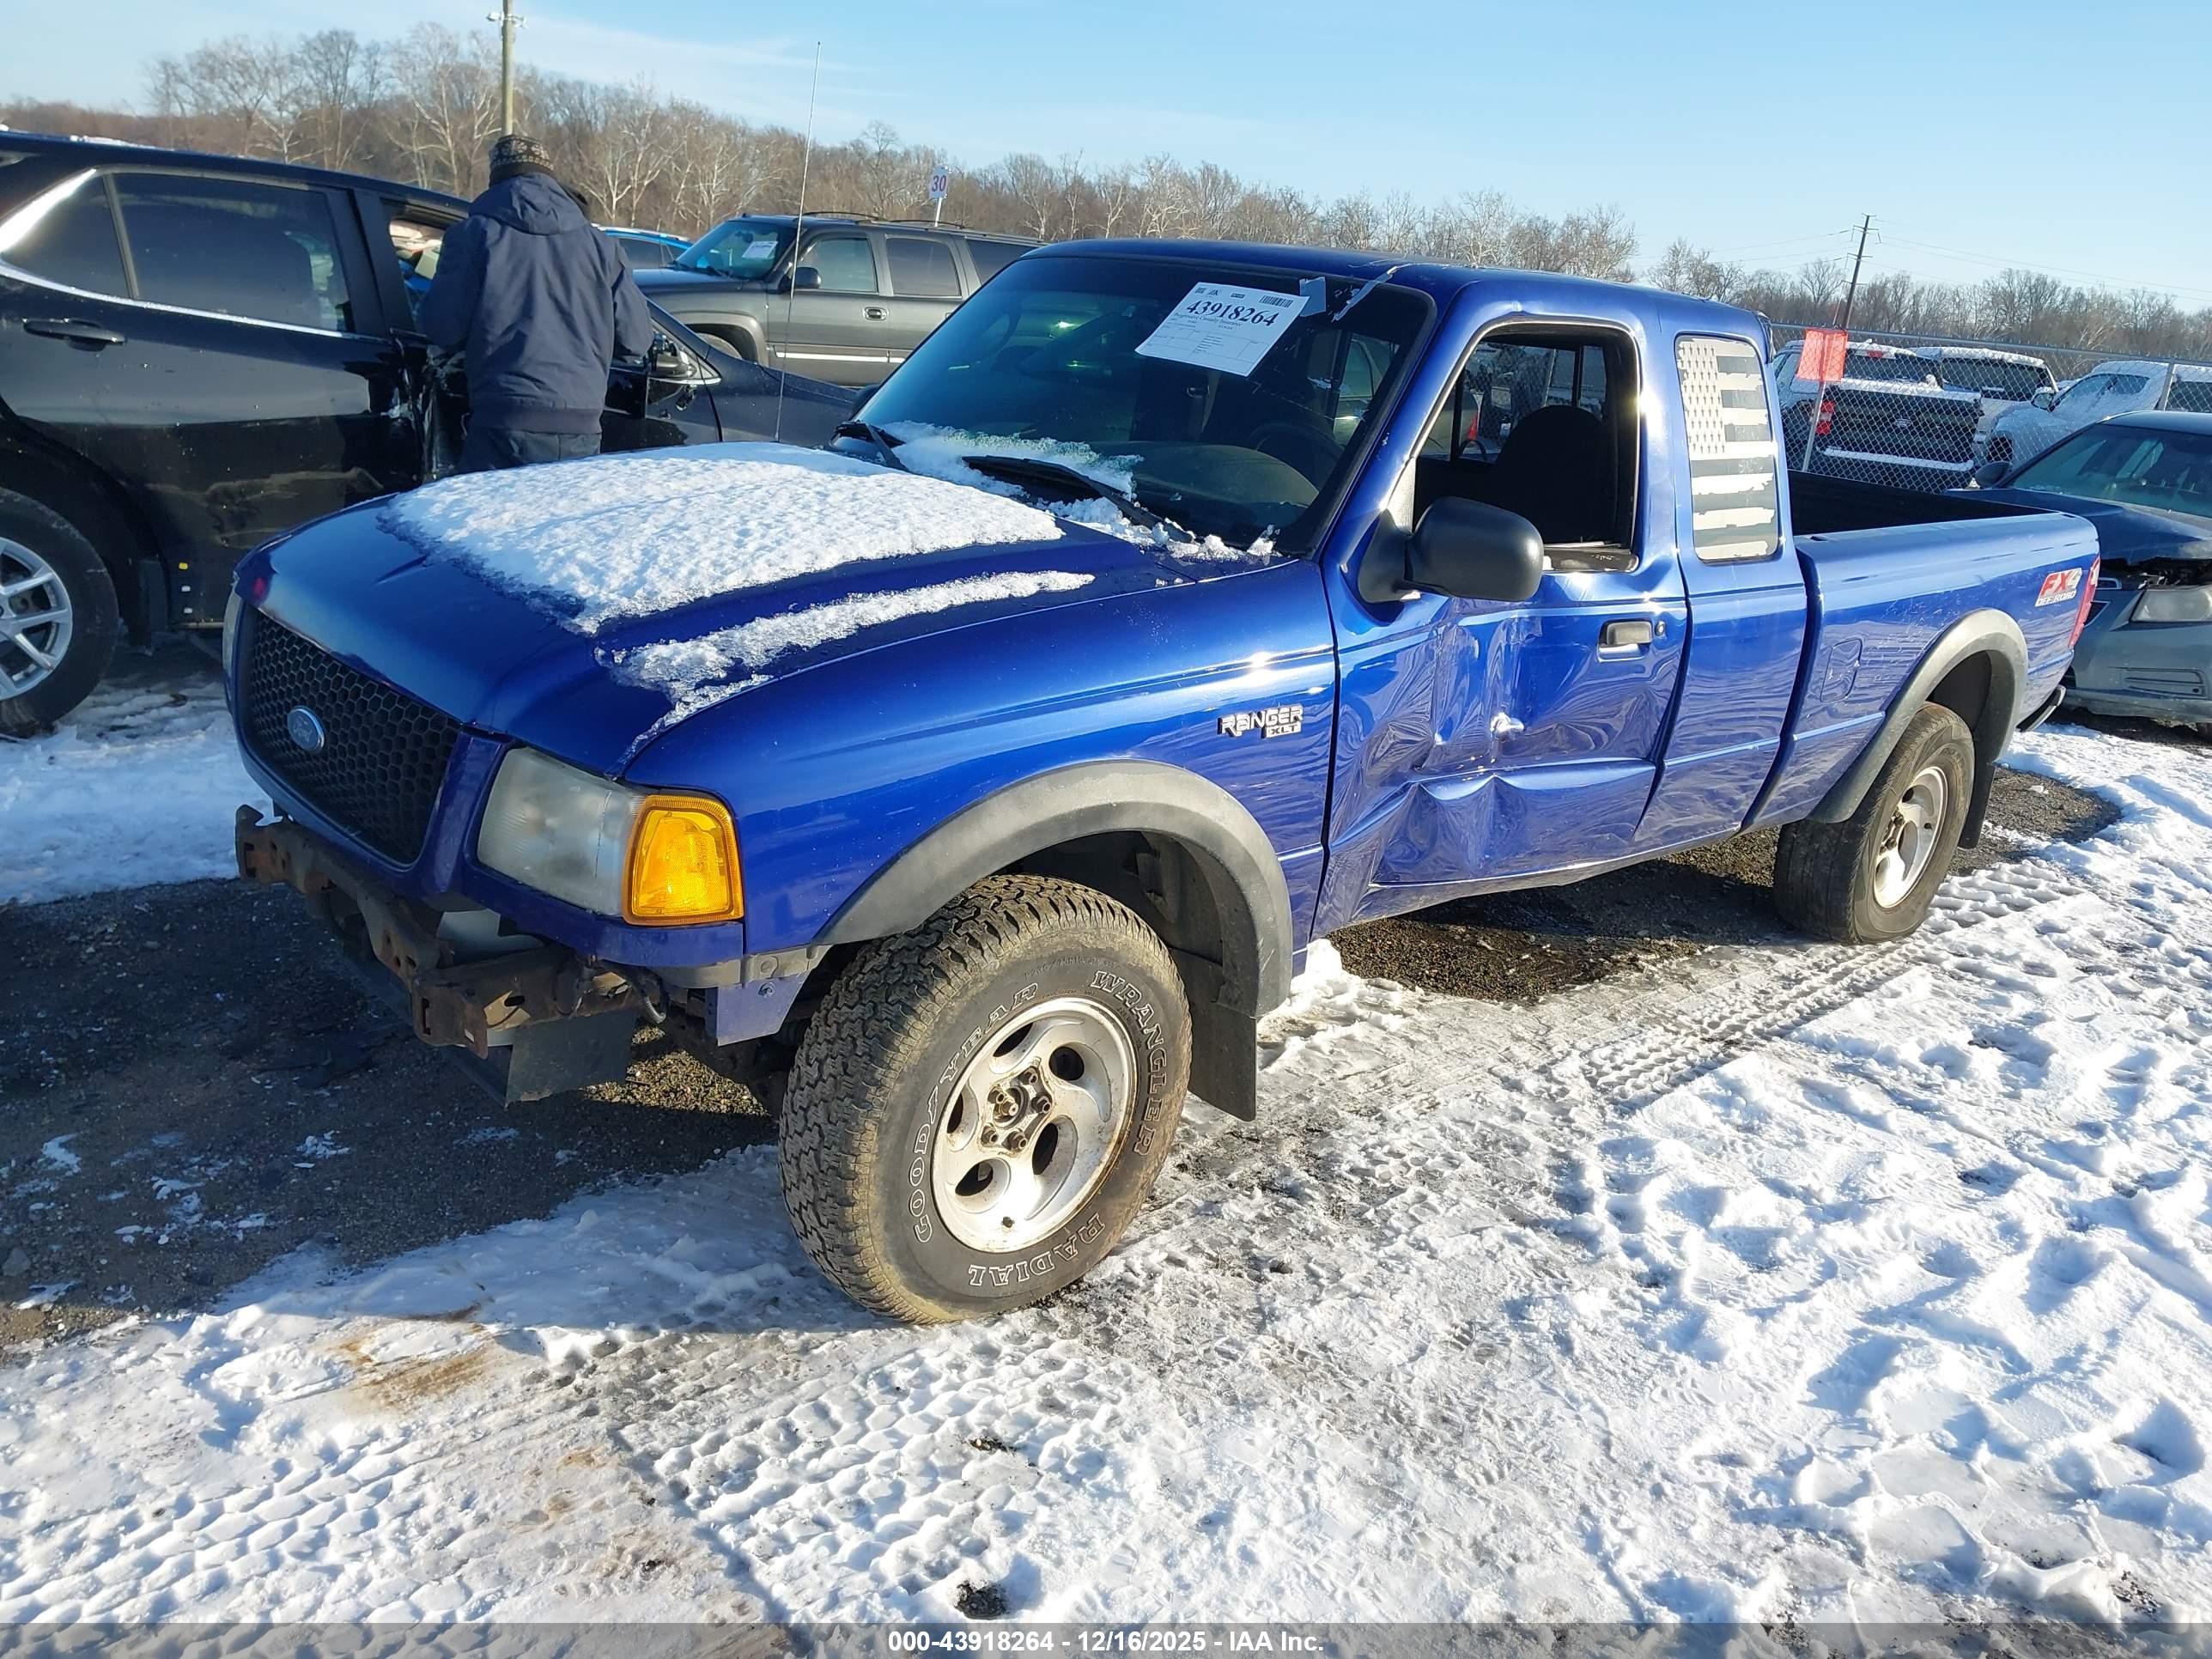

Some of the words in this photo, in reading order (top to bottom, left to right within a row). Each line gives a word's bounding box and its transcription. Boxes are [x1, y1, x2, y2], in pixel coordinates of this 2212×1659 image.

[932, 174, 946, 192] 30
[1187, 301, 1279, 326] 43918264
[2040, 570, 2081, 597] FX4
[1217, 704, 1304, 737] RANGER
[1270, 725, 1297, 735] XLT
[1091, 969, 1168, 1157] WRANGLER
[909, 982, 1038, 1243] GOODYEAR
[967, 1212, 1107, 1287] RADIAL
